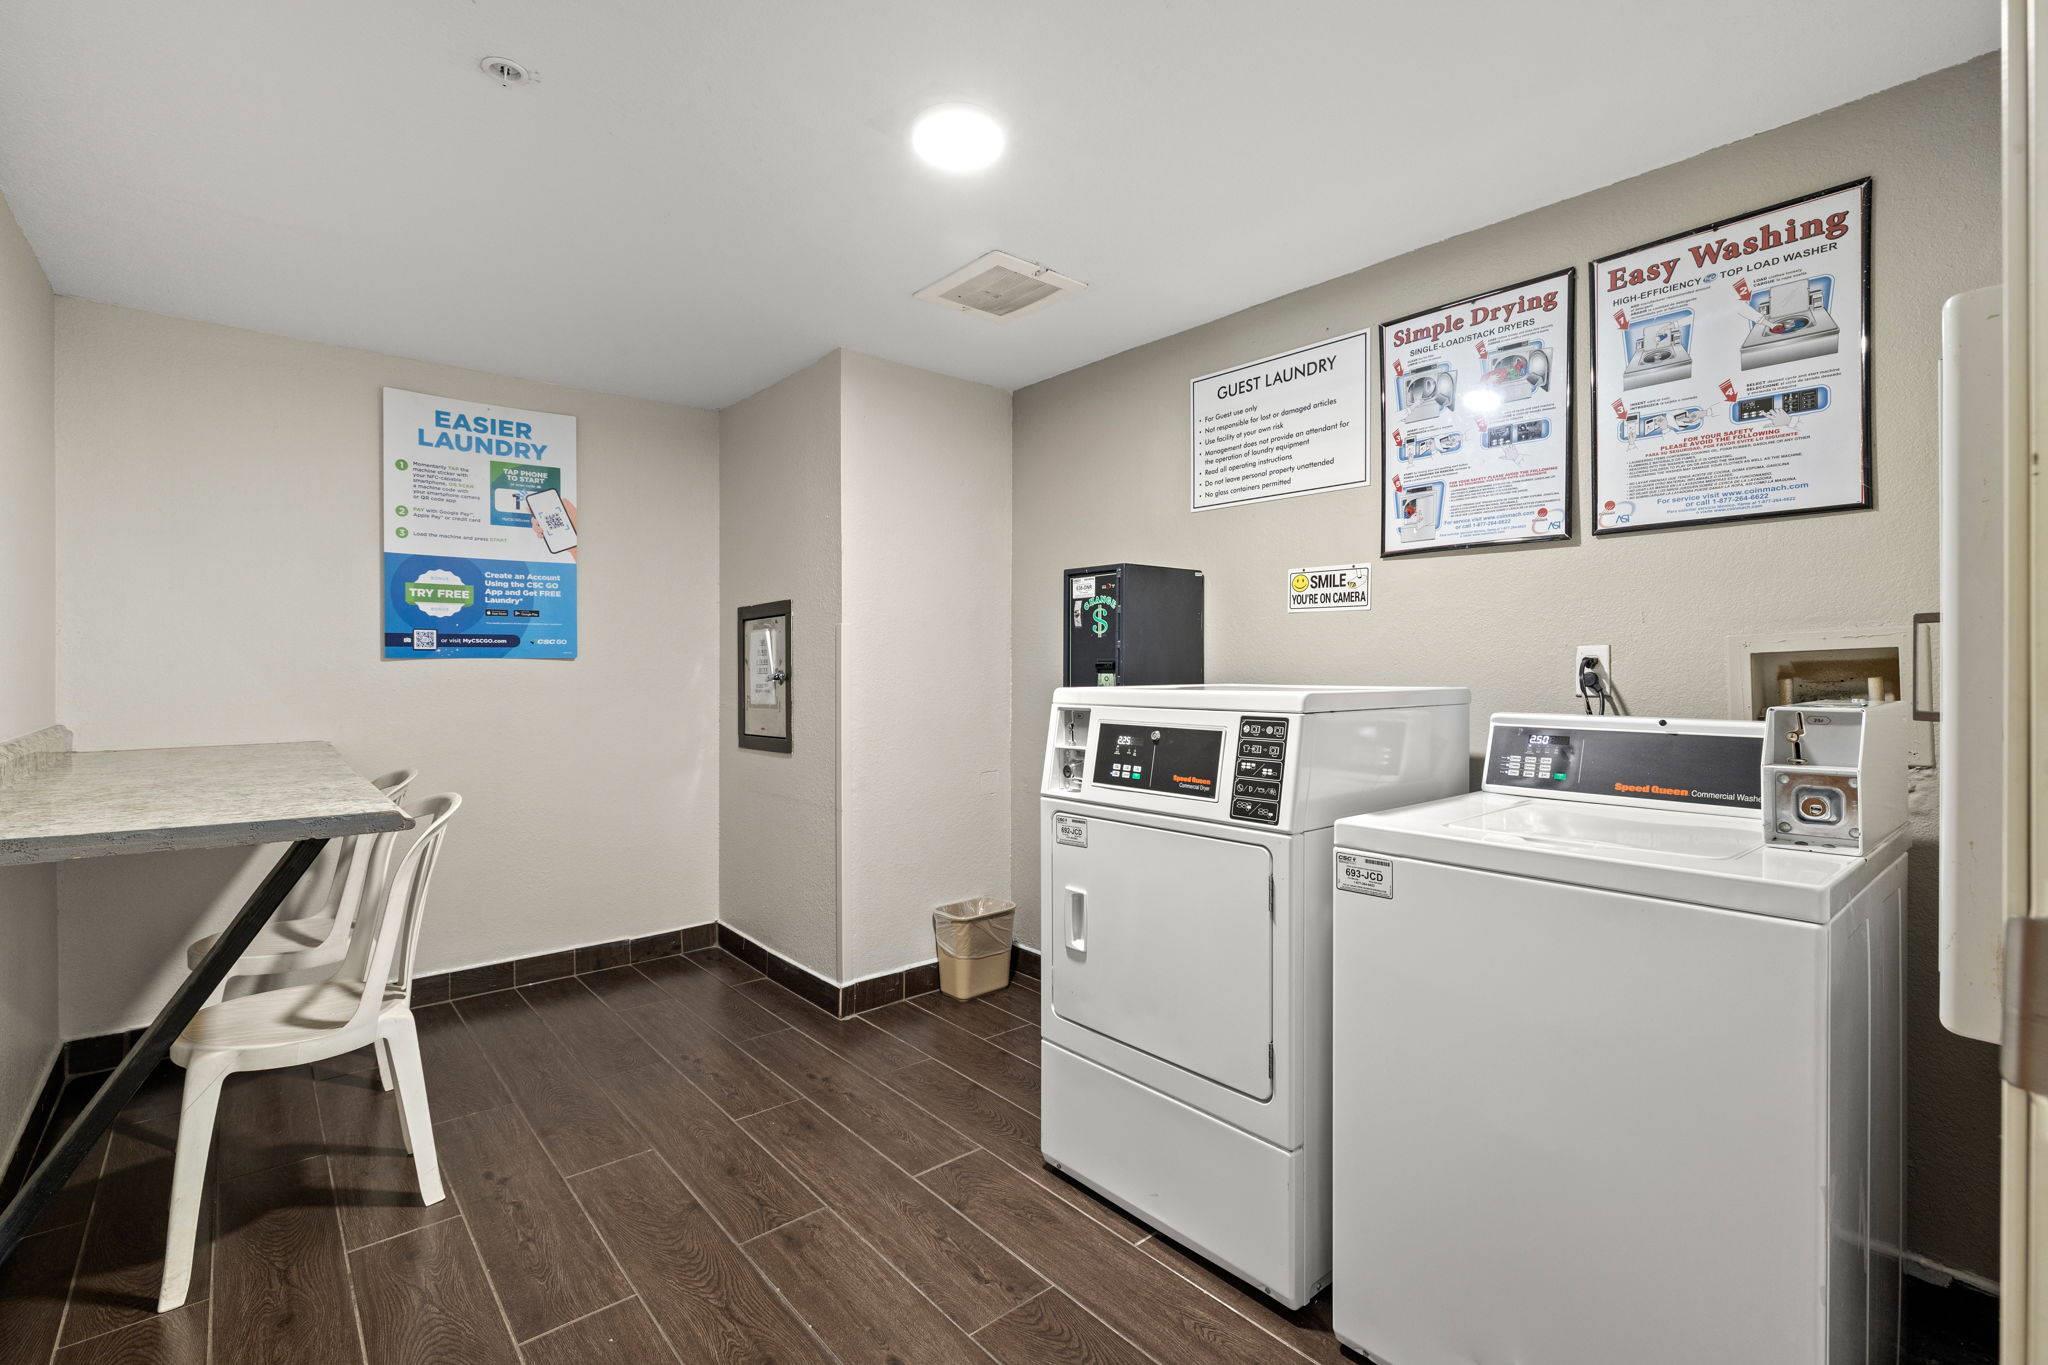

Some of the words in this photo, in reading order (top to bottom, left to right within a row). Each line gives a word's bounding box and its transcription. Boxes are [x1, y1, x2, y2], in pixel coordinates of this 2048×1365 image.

[1608, 258, 1679, 291] Easy
[1690, 212, 1847, 266] Washing
[1613, 278, 1700, 305] HIGH-EFFICIENCY
[1720, 266, 1742, 278] TOP
[1746, 257, 1779, 271] LOAD
[1783, 242, 1836, 261] WASHER
[1393, 315, 1463, 346] Simple
[1470, 291, 1557, 325] Drying
[1410, 328, 1494, 356] SINGLE-LOAD/STACK
[1497, 318, 1534, 333] DRYERS
[1217, 376, 1260, 399] GUEST
[1265, 356, 1335, 386] LAUNDRY
[1215, 411, 1231, 419] Guest
[1216, 419, 1248, 430] responsible
[1280, 403, 1311, 416] damaged
[1312, 398, 1336, 408] articles
[435, 410, 531, 438] EASIER
[1723, 427, 1753, 436] SAFETY
[1204, 444, 1241, 455] Management
[1270, 432, 1293, 443] provide
[1305, 423, 1337, 435] attendant
[1216, 434, 1234, 442] facility
[1243, 429, 1256, 438] your
[1660, 442, 1687, 450] PLEASE
[1689, 438, 1713, 446] AVOID
[1732, 428, 1779, 439] FOLLOWING
[418, 429, 545, 459] LAUNDRY
[1214, 453, 1242, 463] operation
[1251, 446, 1273, 455] laundry
[1275, 439, 1309, 450] equipment
[412, 461, 446, 470] Momentarily
[1228, 461, 1256, 471] operating
[1257, 454, 1292, 464] instructions
[1241, 470, 1267, 481] personal
[1268, 466, 1294, 476] property
[1296, 457, 1334, 470] unattended
[1230, 484, 1260, 493] containers
[1261, 478, 1291, 489] permitted
[1722, 482, 1808, 496] www.coinmach.com
[1713, 492, 1768, 504] 1-877-264-6622
[484, 580, 508, 588] Using
[1310, 574, 1346, 588] SMILE
[409, 587, 433, 597] TRY
[437, 589, 469, 598] FREE
[1292, 594, 1318, 604] YOU'RE
[1320, 592, 1331, 603] ON
[1333, 591, 1366, 603] CAMERA
[1084, 595, 1116, 610] CHANGE
[1172, 774, 1191, 783] Speed
[1192, 777, 1211, 785] Queen
[1178, 782, 1199, 790] Commercial
[1615, 782, 1649, 793] Speed
[1650, 785, 1689, 796] Queen
[1691, 789, 1735, 800] Commercial
[1736, 793, 1761, 803] Washe
[1061, 826, 1082, 836] 692-JCD
[1346, 868, 1383, 882] 693-JCD
